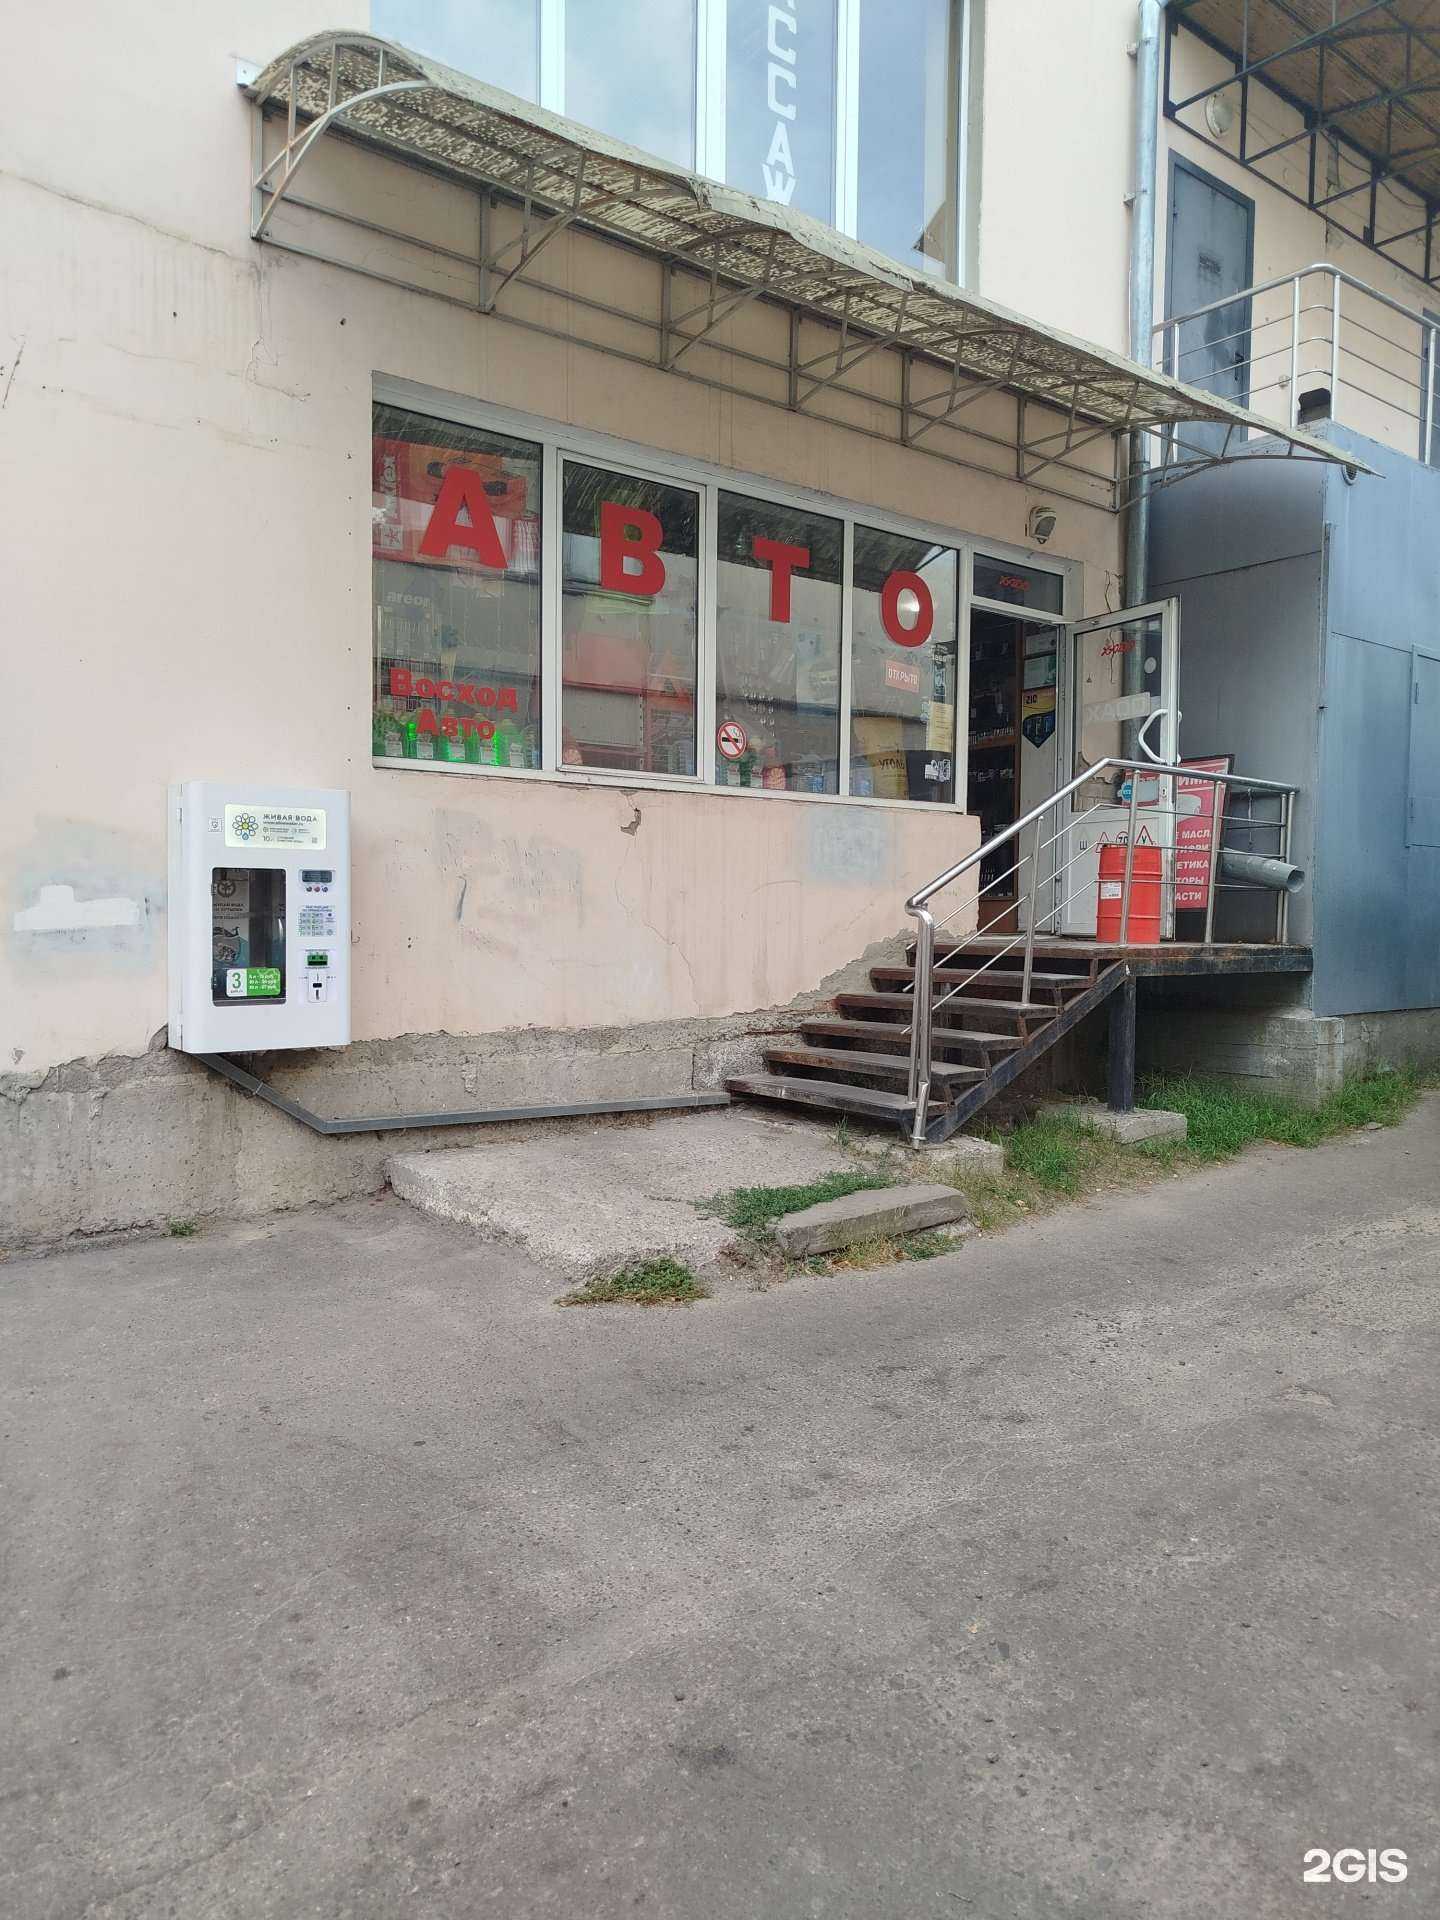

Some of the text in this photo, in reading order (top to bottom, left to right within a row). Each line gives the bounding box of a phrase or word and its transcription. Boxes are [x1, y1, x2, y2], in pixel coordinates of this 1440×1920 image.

[418, 465, 934, 648] АВТО
[887, 667, 919, 686] ОТКРЫТО
[390, 667, 519, 713] Восход
[415, 708, 496, 740] Авто
[878, 758, 906, 771] УГОЛЬ
[295, 815, 318, 823] ВОДА
[1181, 829, 1211, 839] МАСЛ
[232, 972, 241, 989] 3
